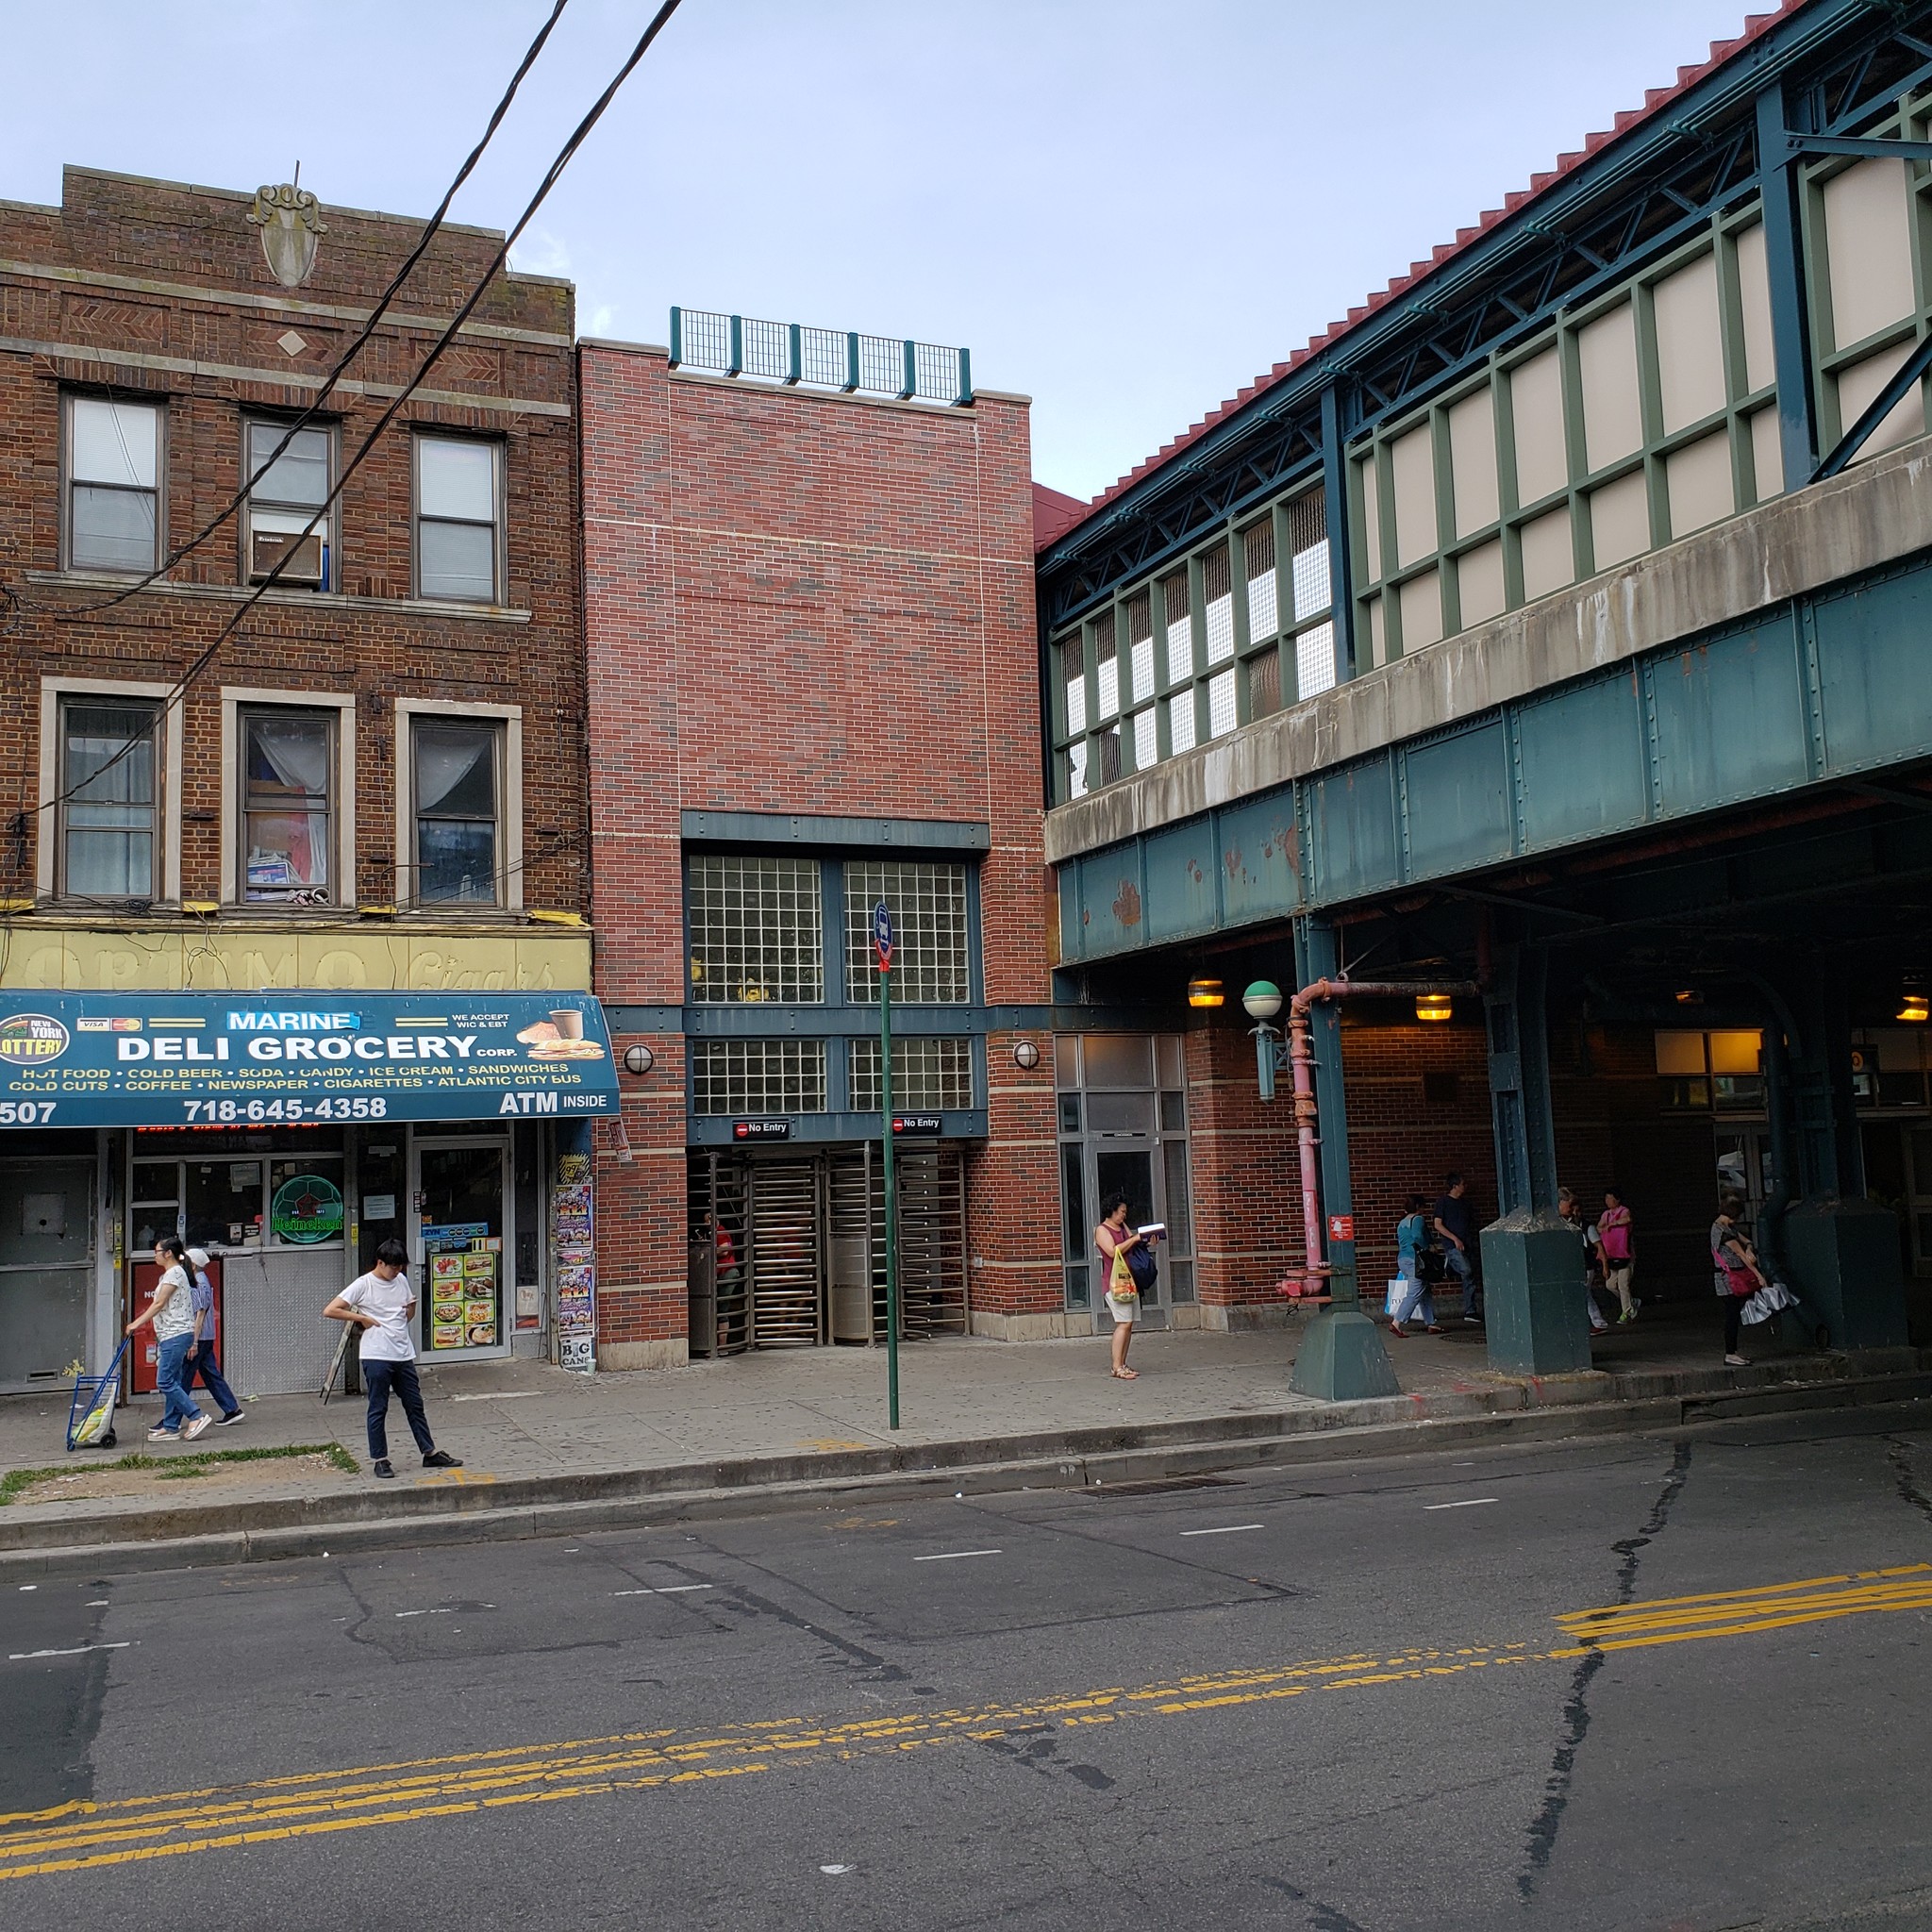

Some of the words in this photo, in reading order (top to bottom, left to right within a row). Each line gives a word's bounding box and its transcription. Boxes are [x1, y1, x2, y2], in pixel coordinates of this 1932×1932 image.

[229, 1012, 350, 1030] MARINE
[31, 1026, 63, 1039] YORK
[0, 1039, 62, 1056] OTTERY
[118, 1037, 229, 1060] DELI
[248, 1036, 478, 1060] GROCERY
[476, 1048, 518, 1058] CORP.
[62, 1069, 111, 1078] FOOD
[127, 1069, 175, 1078] COLD
[178, 1068, 222, 1078] BEER
[239, 1068, 284, 1077] SODA
[300, 1067, 354, 1076] CANDY
[369, 1067, 395, 1076] ICE
[399, 1066, 454, 1075] CREAM
[468, 1064, 569, 1074] SANDWICHES
[8, 1081, 58, 1091] COLD
[62, 1081, 108, 1091] CUTS
[125, 1080, 192, 1091] COFFEE
[208, 1079, 308, 1090] NEWSPAPER
[324, 1077, 423, 1089] CIGARETTES
[438, 1076, 511, 1087] ATLANTIC
[515, 1075, 547, 1085] CITY
[553, 1074, 582, 1084] BUS
[0, 1102, 57, 1124] 507
[184, 1097, 387, 1122] 718-645-4358
[499, 1091, 558, 1114] ATM
[563, 1095, 608, 1108] INSIDE
[748, 1124, 761, 1132] No
[764, 1124, 787, 1132] Entry
[903, 1119, 915, 1127] No
[918, 1119, 940, 1128] Entry
[271, 1217, 343, 1231] Heineken
